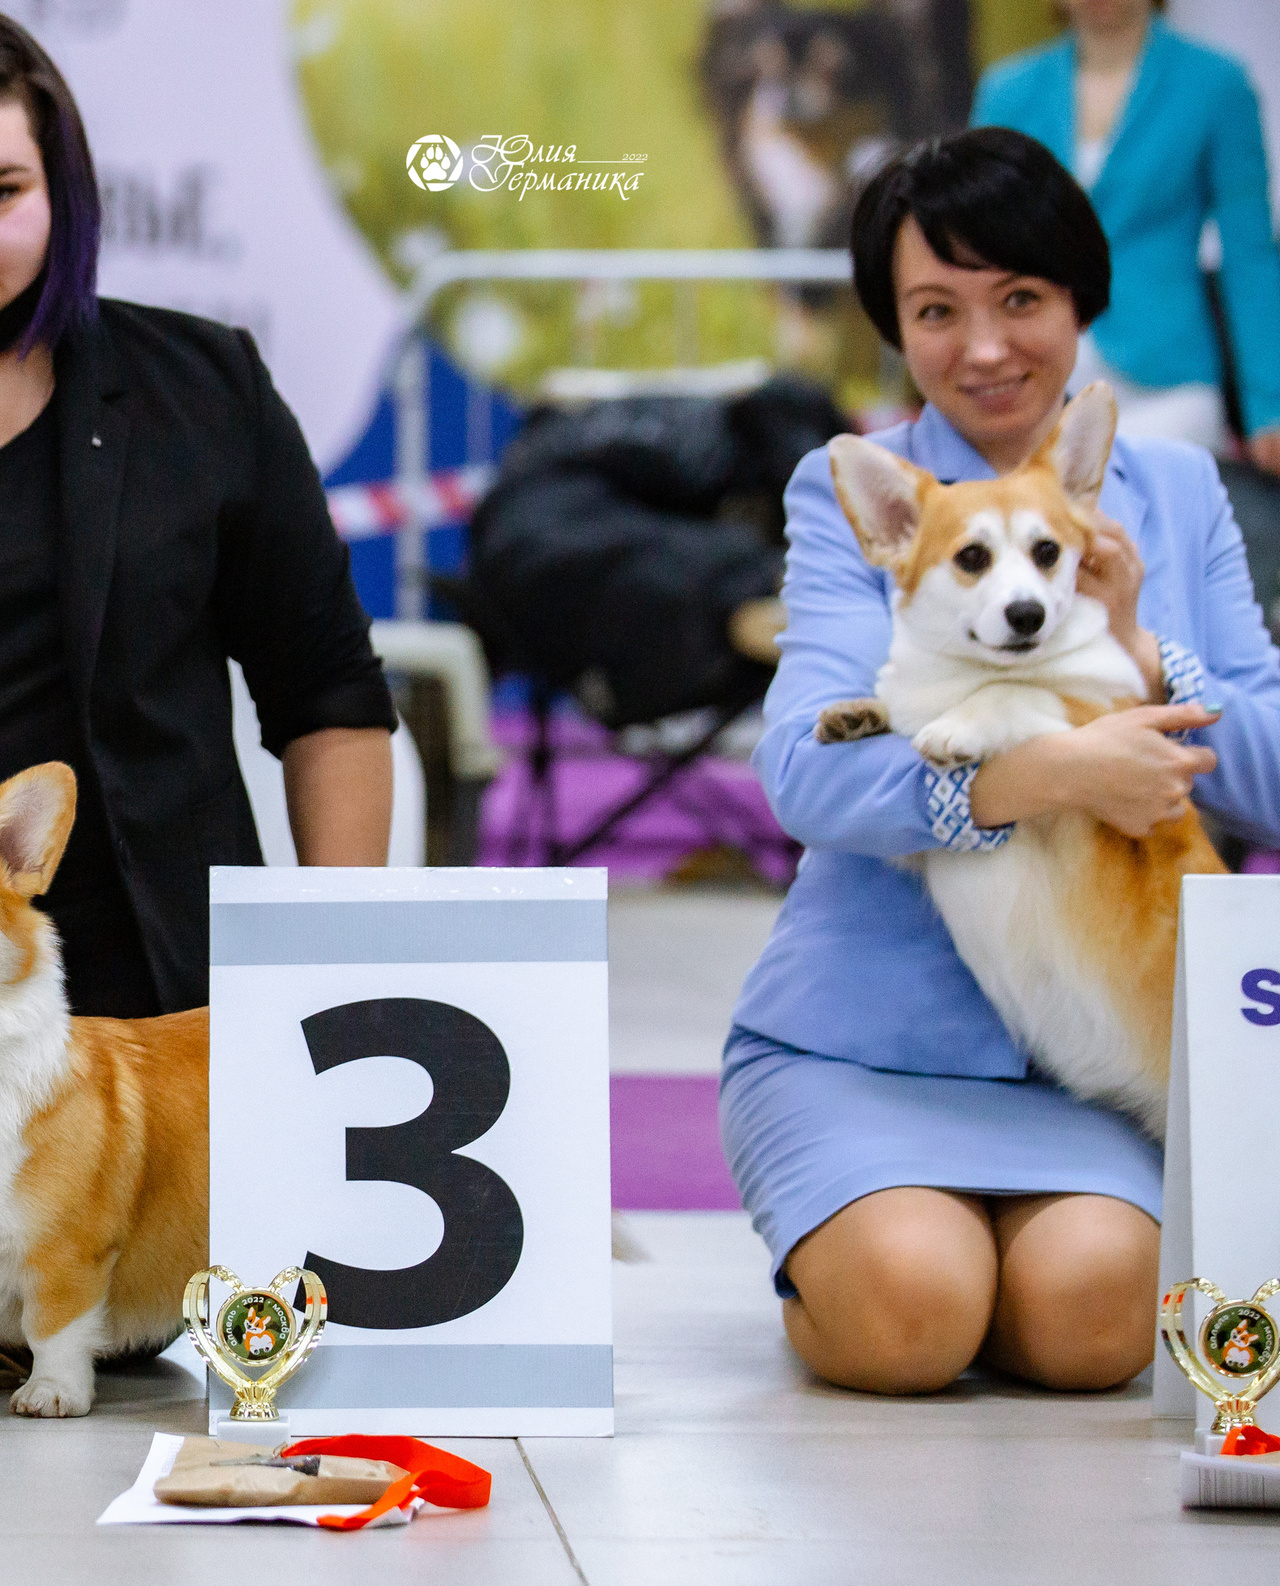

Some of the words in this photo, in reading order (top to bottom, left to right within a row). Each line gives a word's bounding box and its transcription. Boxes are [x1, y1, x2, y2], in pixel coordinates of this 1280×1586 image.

[293, 997, 524, 1331] 3
[241, 1296, 264, 1306] 2022
[1237, 1308, 1261, 1321] 2022
